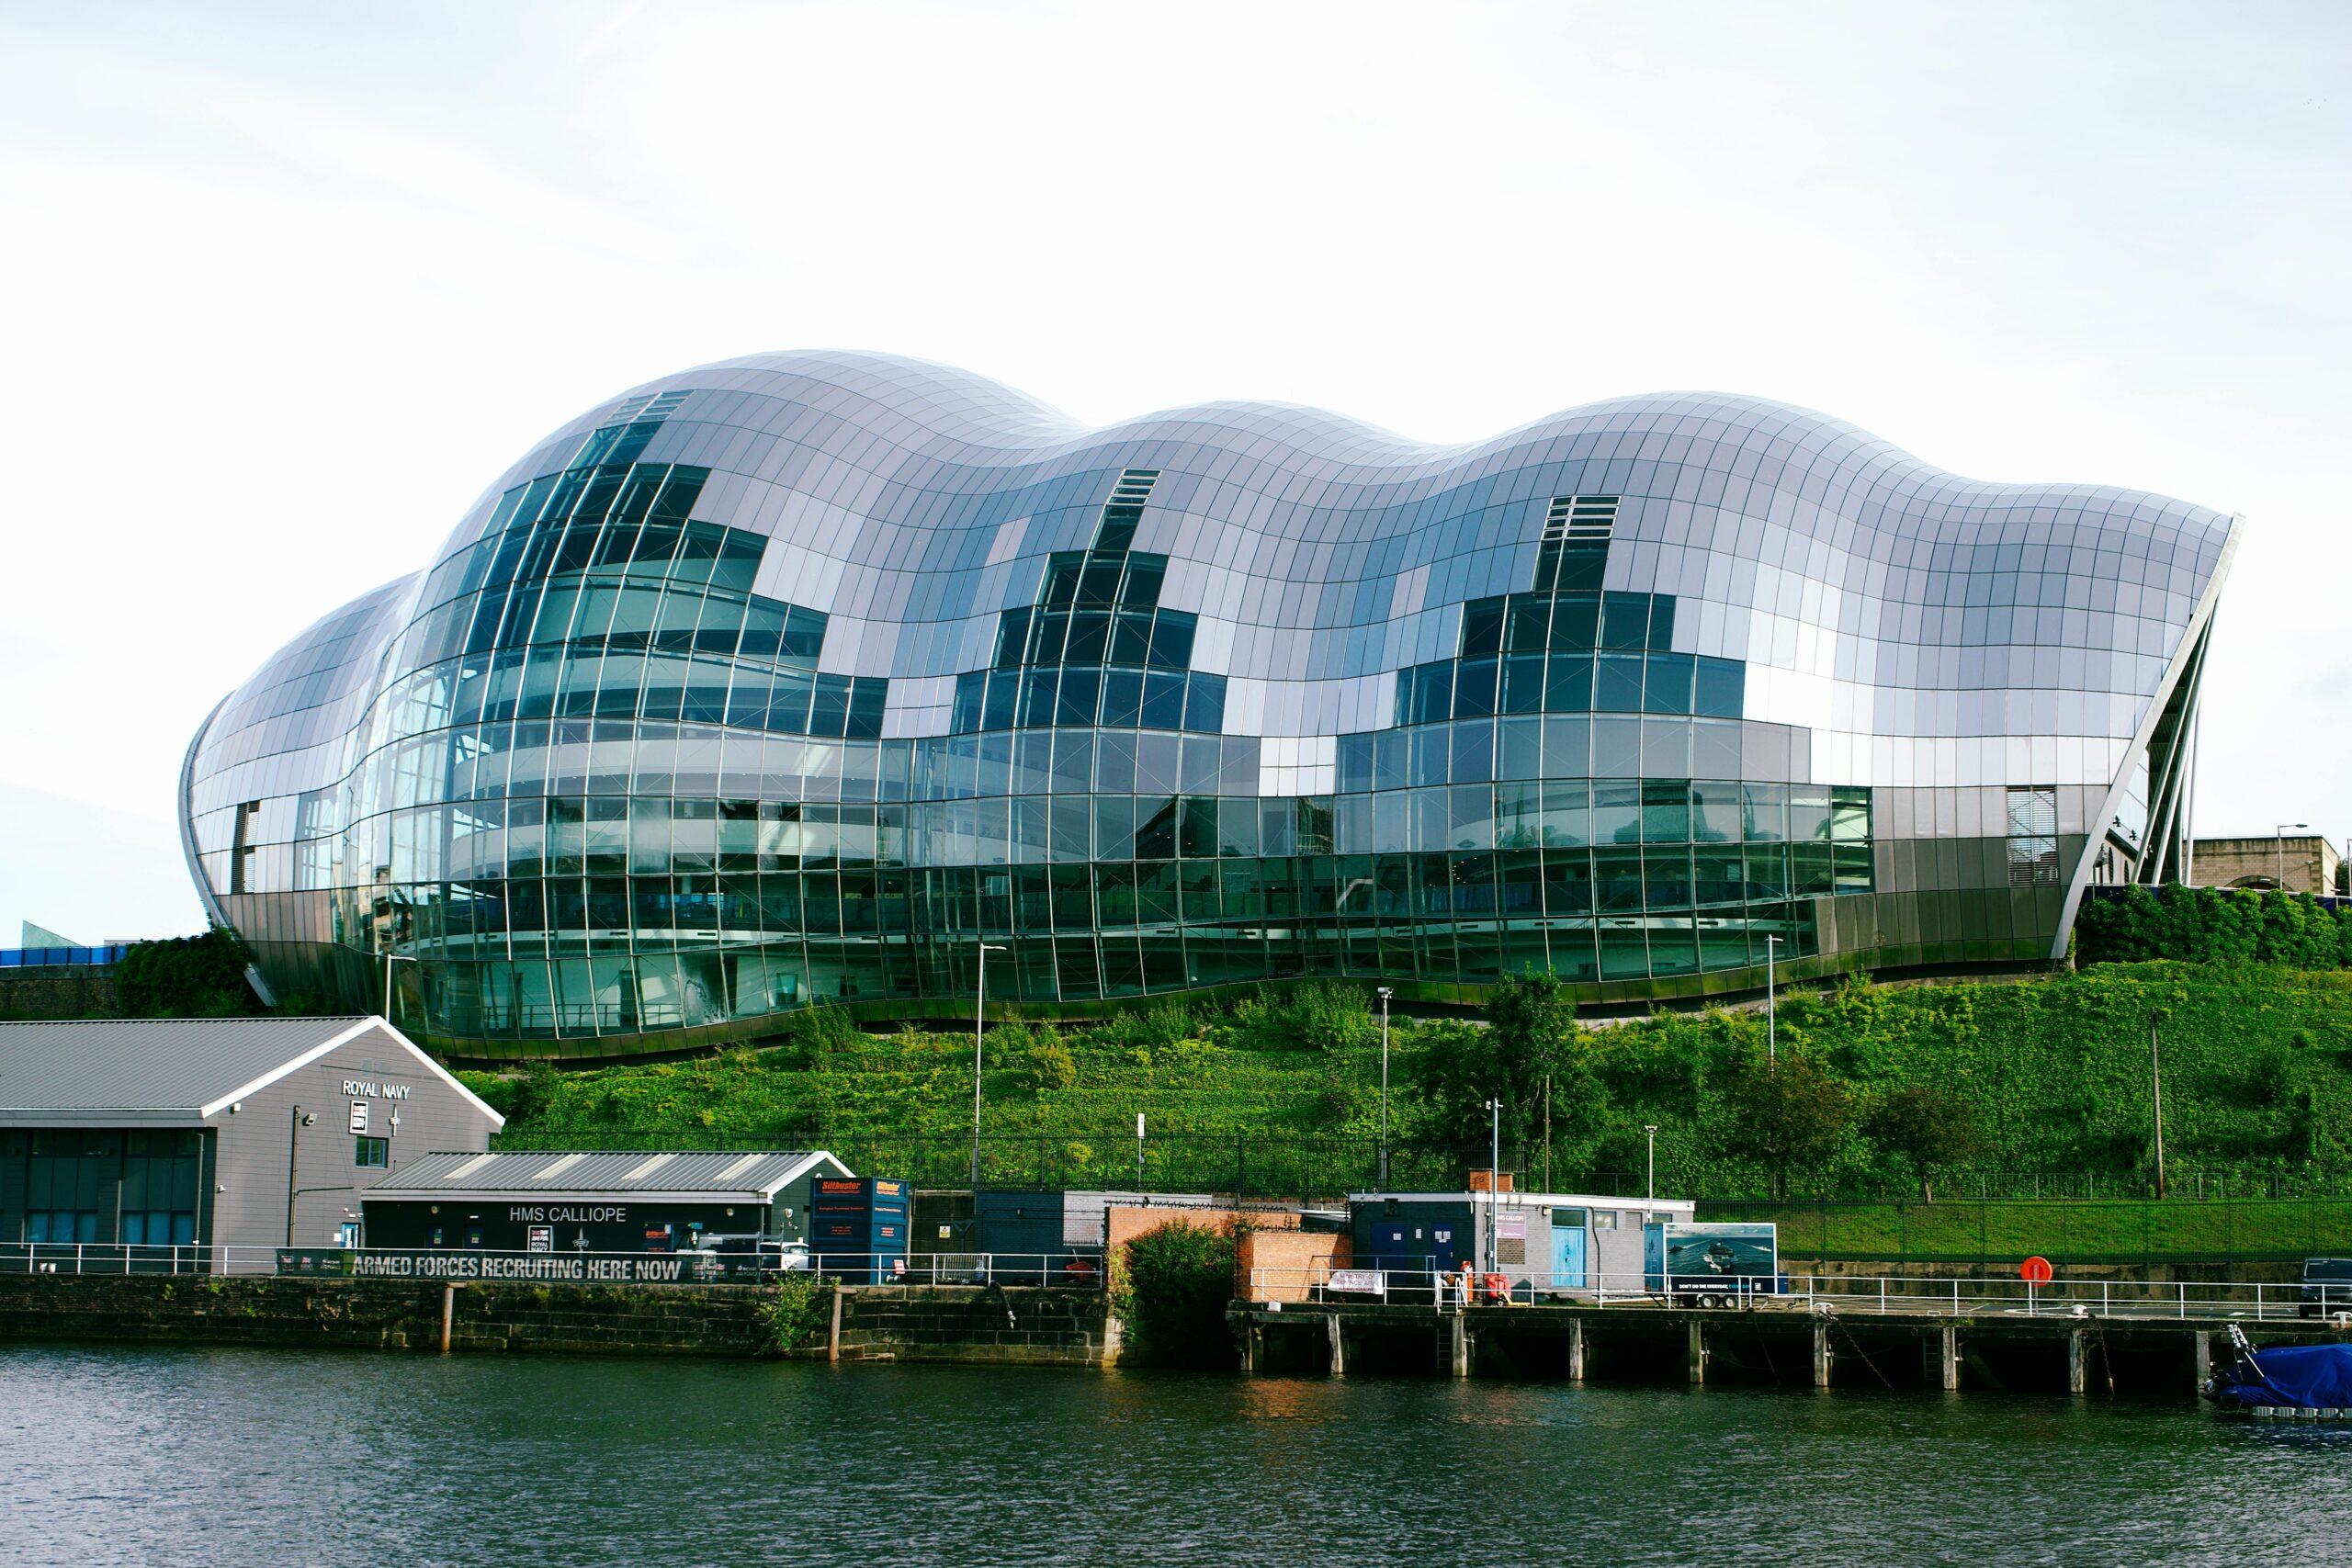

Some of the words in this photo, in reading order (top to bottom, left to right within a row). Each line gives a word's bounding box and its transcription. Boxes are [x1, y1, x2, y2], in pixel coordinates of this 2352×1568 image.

[343, 1080, 378, 1098] ROYAL
[382, 1084, 411, 1100] NAVY
[510, 1207, 544, 1222] HMS
[548, 1207, 627, 1223] CALLIOPE
[352, 1256, 412, 1276] ARMED
[416, 1257, 478, 1277] FORCES
[482, 1258, 585, 1279] RECRUITING
[589, 1259, 632, 1280] HERE
[636, 1260, 682, 1280] NOW
